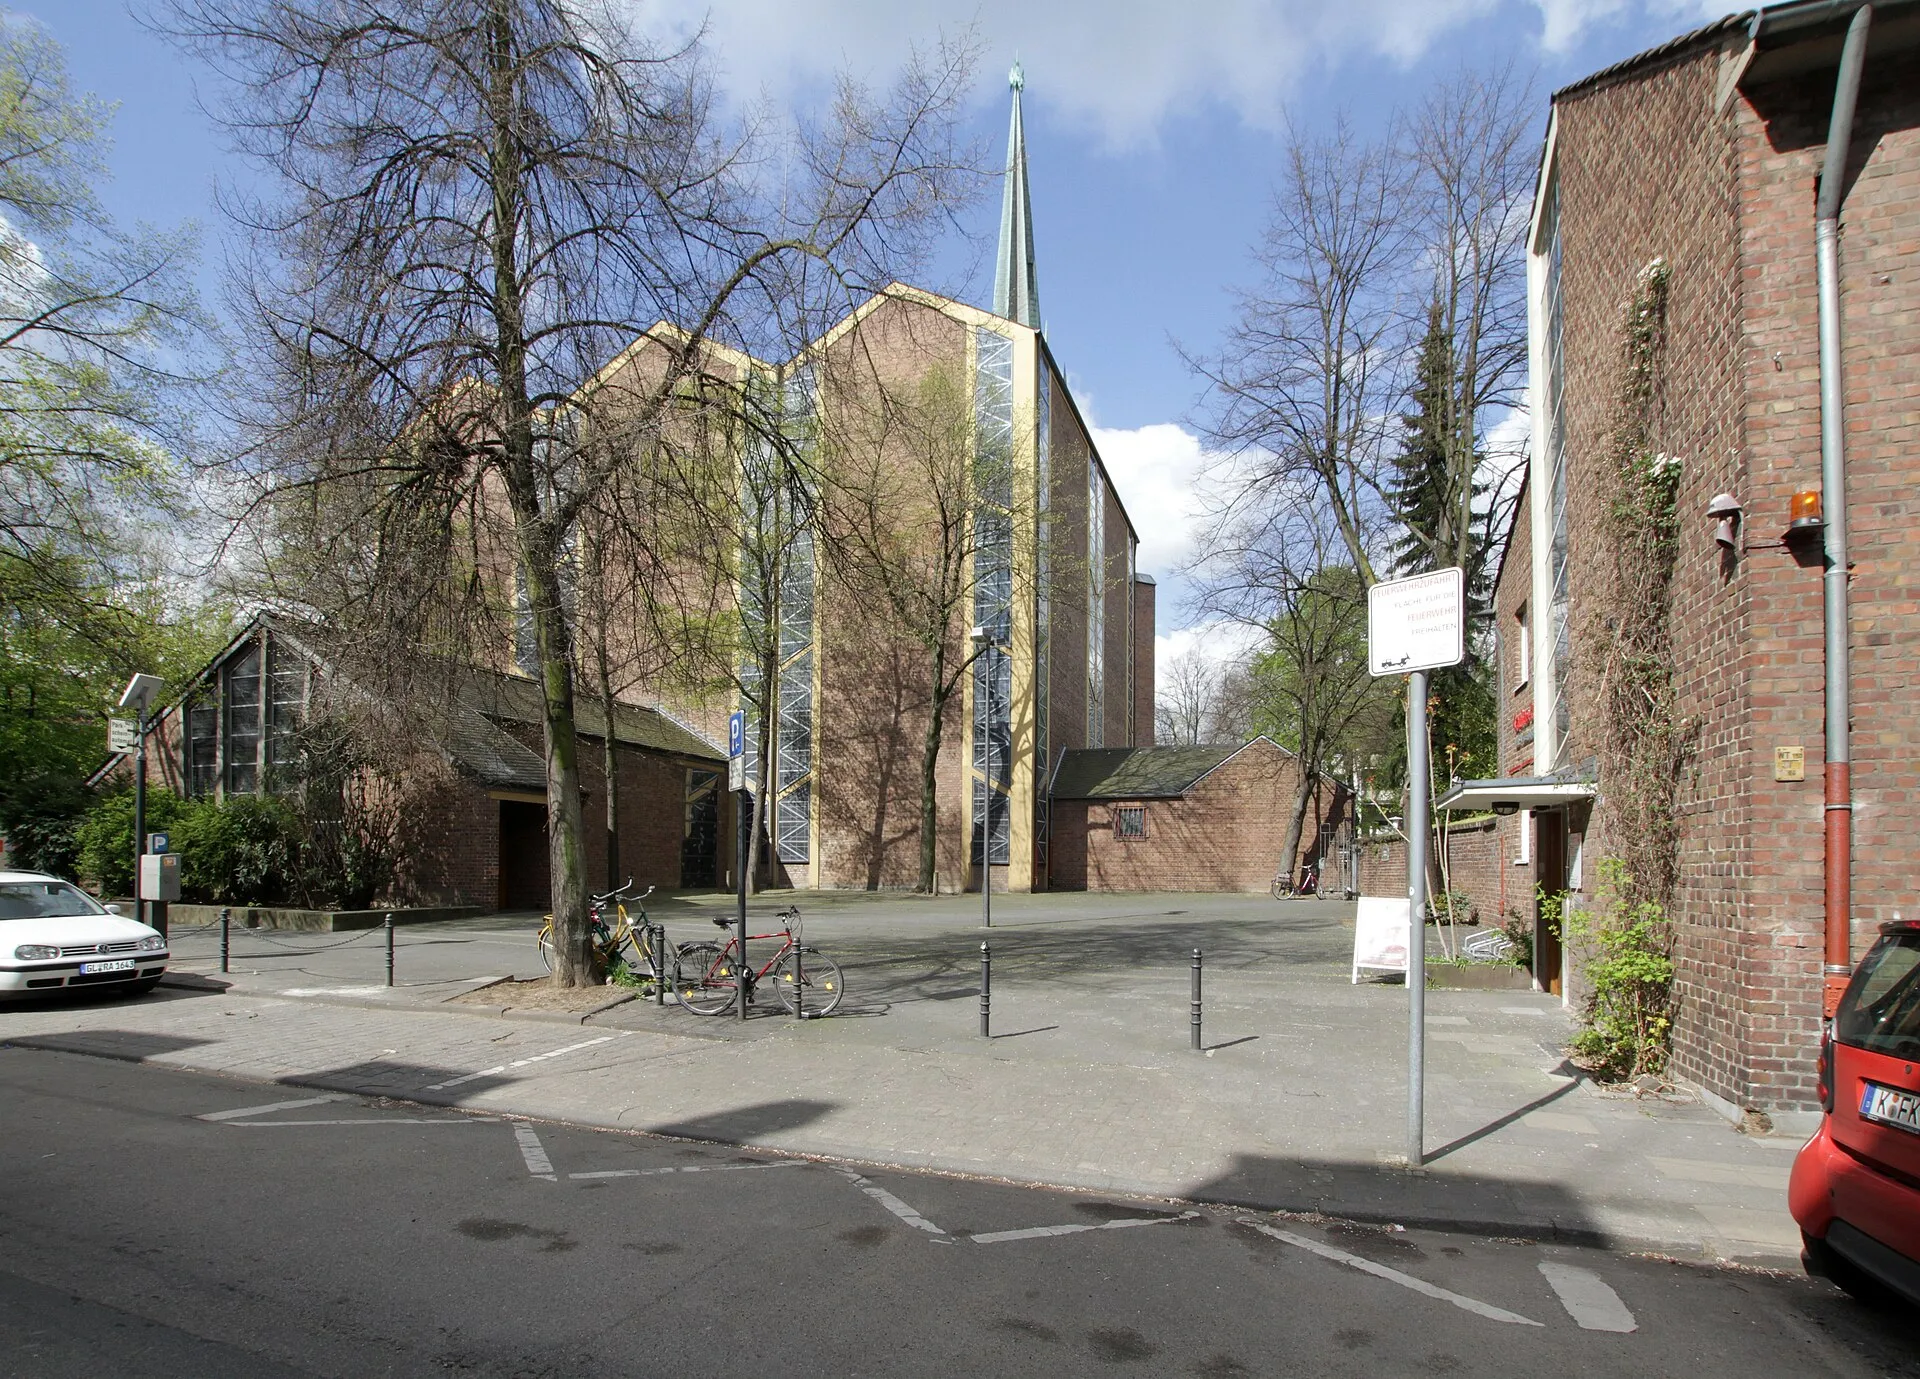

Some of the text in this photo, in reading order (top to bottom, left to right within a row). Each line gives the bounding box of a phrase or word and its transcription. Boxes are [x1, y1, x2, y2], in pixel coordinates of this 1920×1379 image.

[1373, 574, 1456, 598] FEUERWEHRZUFAHRT
[1407, 605, 1457, 621] FEUERWEHR
[1411, 623, 1457, 636] FREIHALTEN
[731, 719, 740, 752] P
[154, 836, 166, 849] P
[86, 960, 134, 973] GL RA 1643
[1877, 1091, 1892, 1115] K
